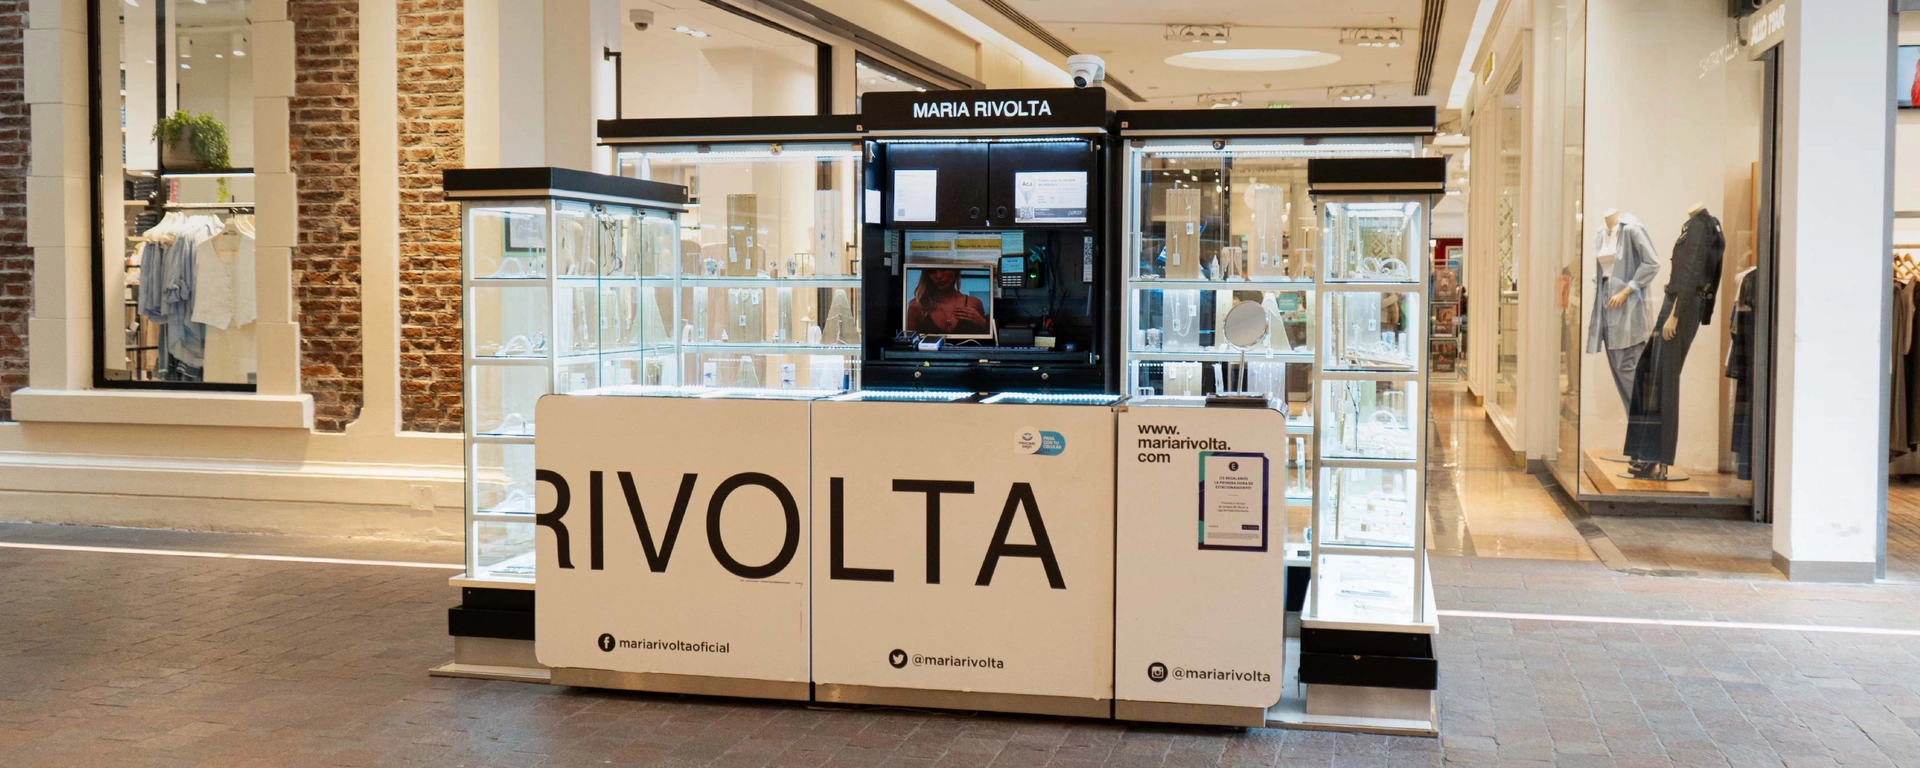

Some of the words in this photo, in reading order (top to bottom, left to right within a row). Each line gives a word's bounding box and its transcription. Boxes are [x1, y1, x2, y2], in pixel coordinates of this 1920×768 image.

[913, 101, 970, 118] MARIA
[974, 99, 1052, 117] RIVOLTA
[1138, 424, 1180, 435] www.
[1138, 437, 1231, 451] mariarivolta.
[1138, 453, 1170, 463] com
[536, 468, 1066, 589] RIVOLTA
[618, 636, 730, 654] mariarivoltaoficial
[912, 652, 1004, 670] @mariarivolta
[1172, 666, 1271, 683] @mariarivolta
